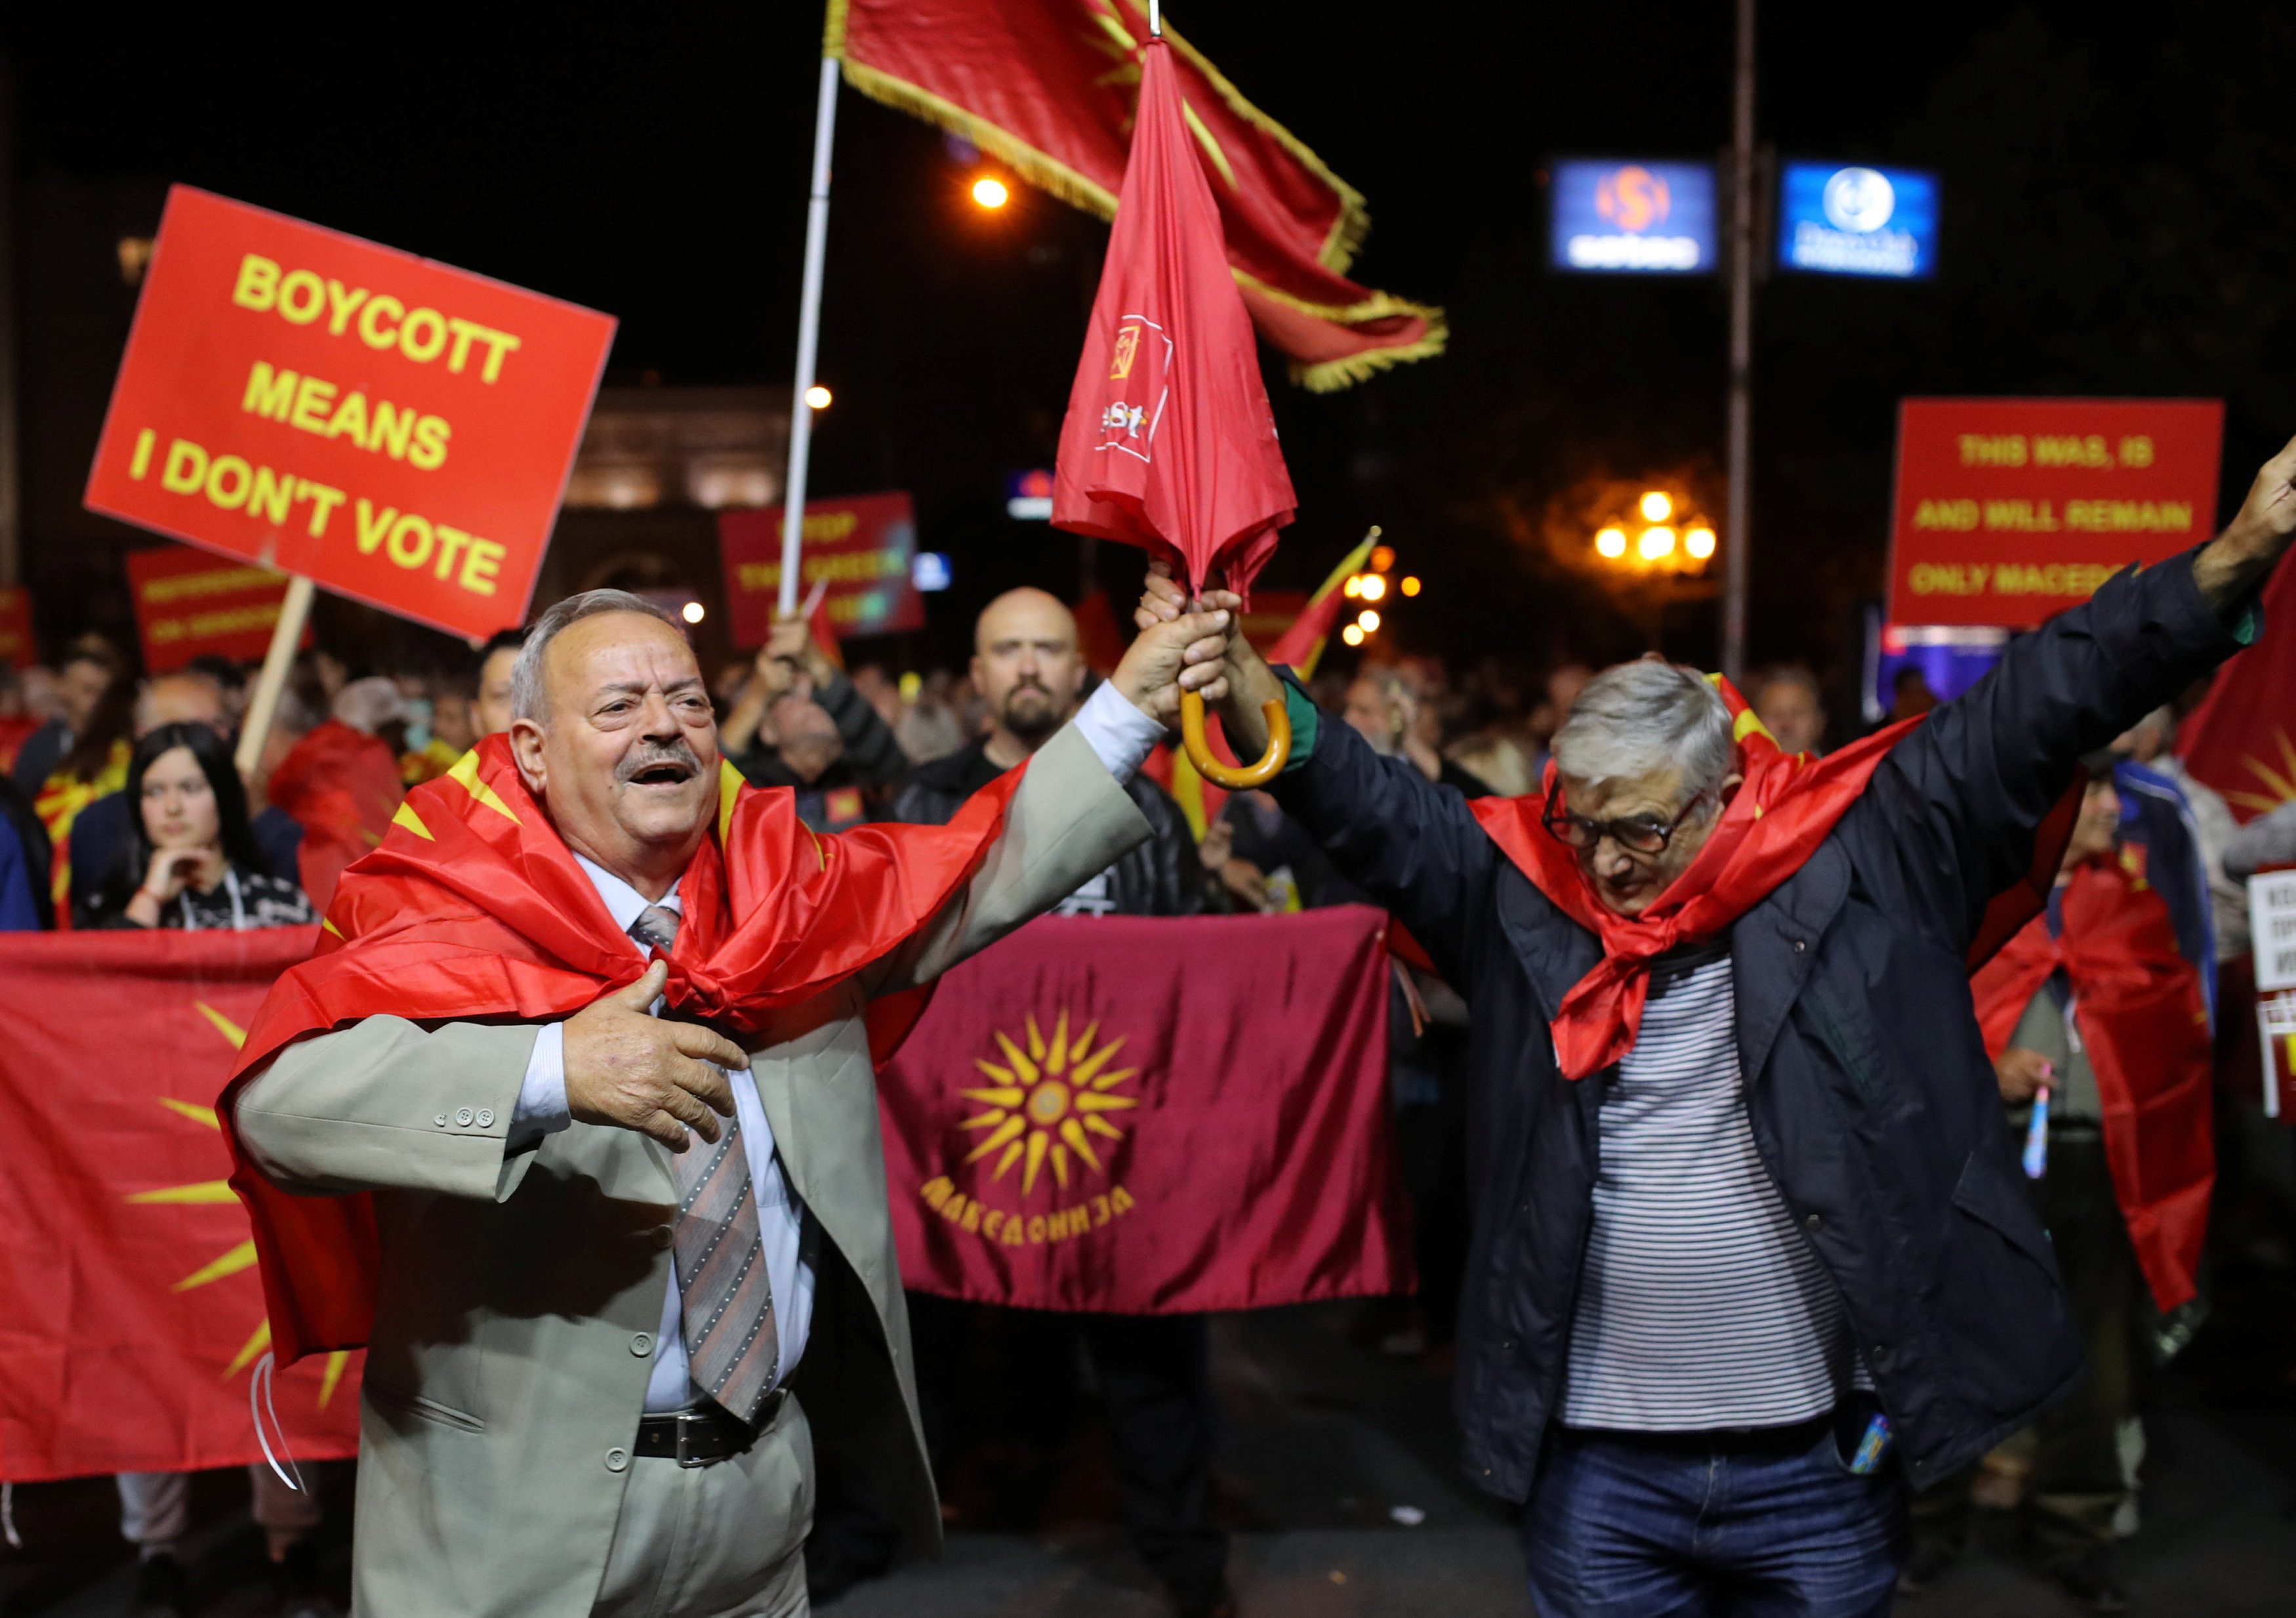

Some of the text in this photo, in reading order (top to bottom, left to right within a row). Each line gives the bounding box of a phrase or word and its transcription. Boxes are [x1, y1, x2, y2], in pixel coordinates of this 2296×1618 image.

[233, 254, 521, 384] BOYCOTT
[242, 362, 451, 471] MEANS
[1958, 434, 2154, 471] THIS WAS, IS
[129, 429, 507, 597] I DON'T VOTE
[1914, 499, 2192, 532] AND WILL REMAIN
[1908, 562, 2132, 596] ONLY MACED
